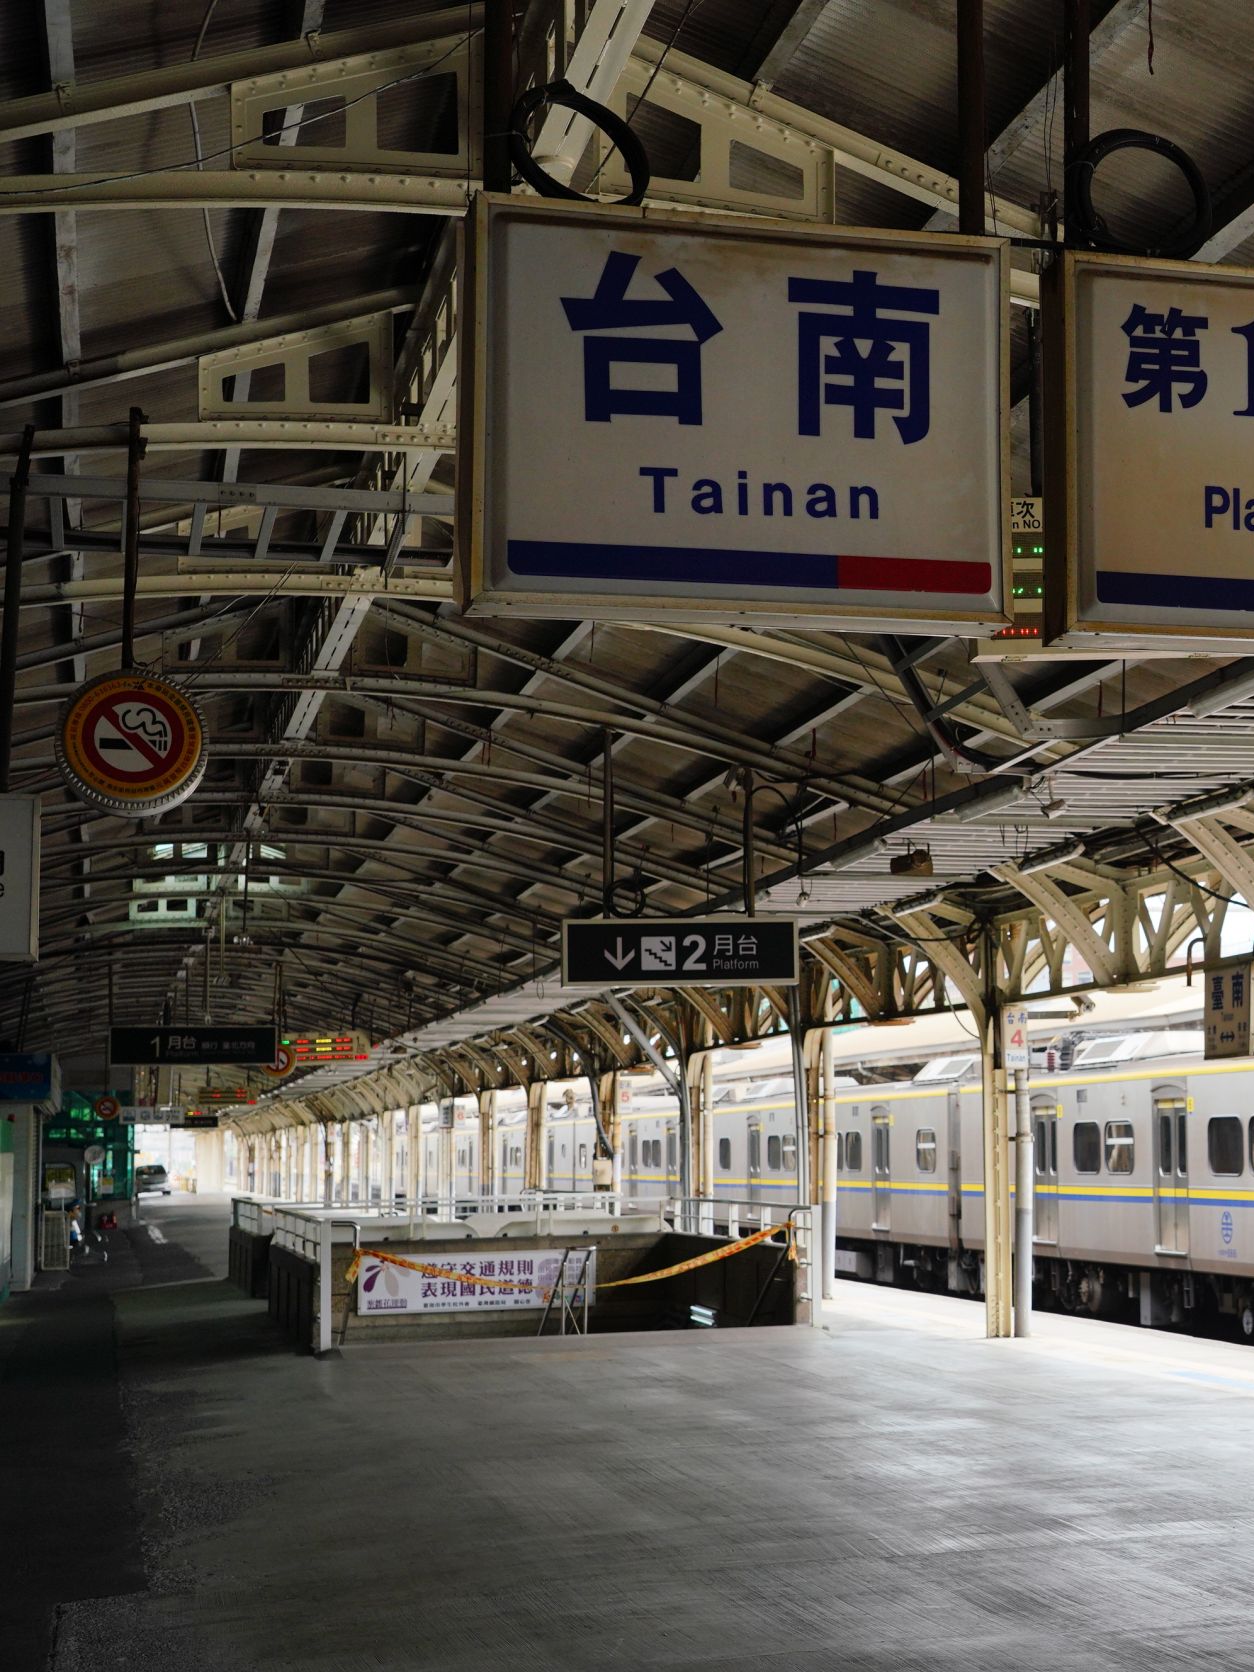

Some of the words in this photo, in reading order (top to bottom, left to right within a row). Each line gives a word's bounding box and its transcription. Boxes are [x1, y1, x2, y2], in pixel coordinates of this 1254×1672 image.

[559, 251, 940, 445] 台南
[639, 466, 880, 520] Tainan
[682, 934, 707, 970] 2
[713, 934, 759, 956] 月台
[712, 957, 760, 970] Platform
[149, 1035, 161, 1058] 1
[167, 1035, 197, 1050] 月台
[1010, 1028, 1024, 1047] 4
[621, 1091, 630, 1103] 5
